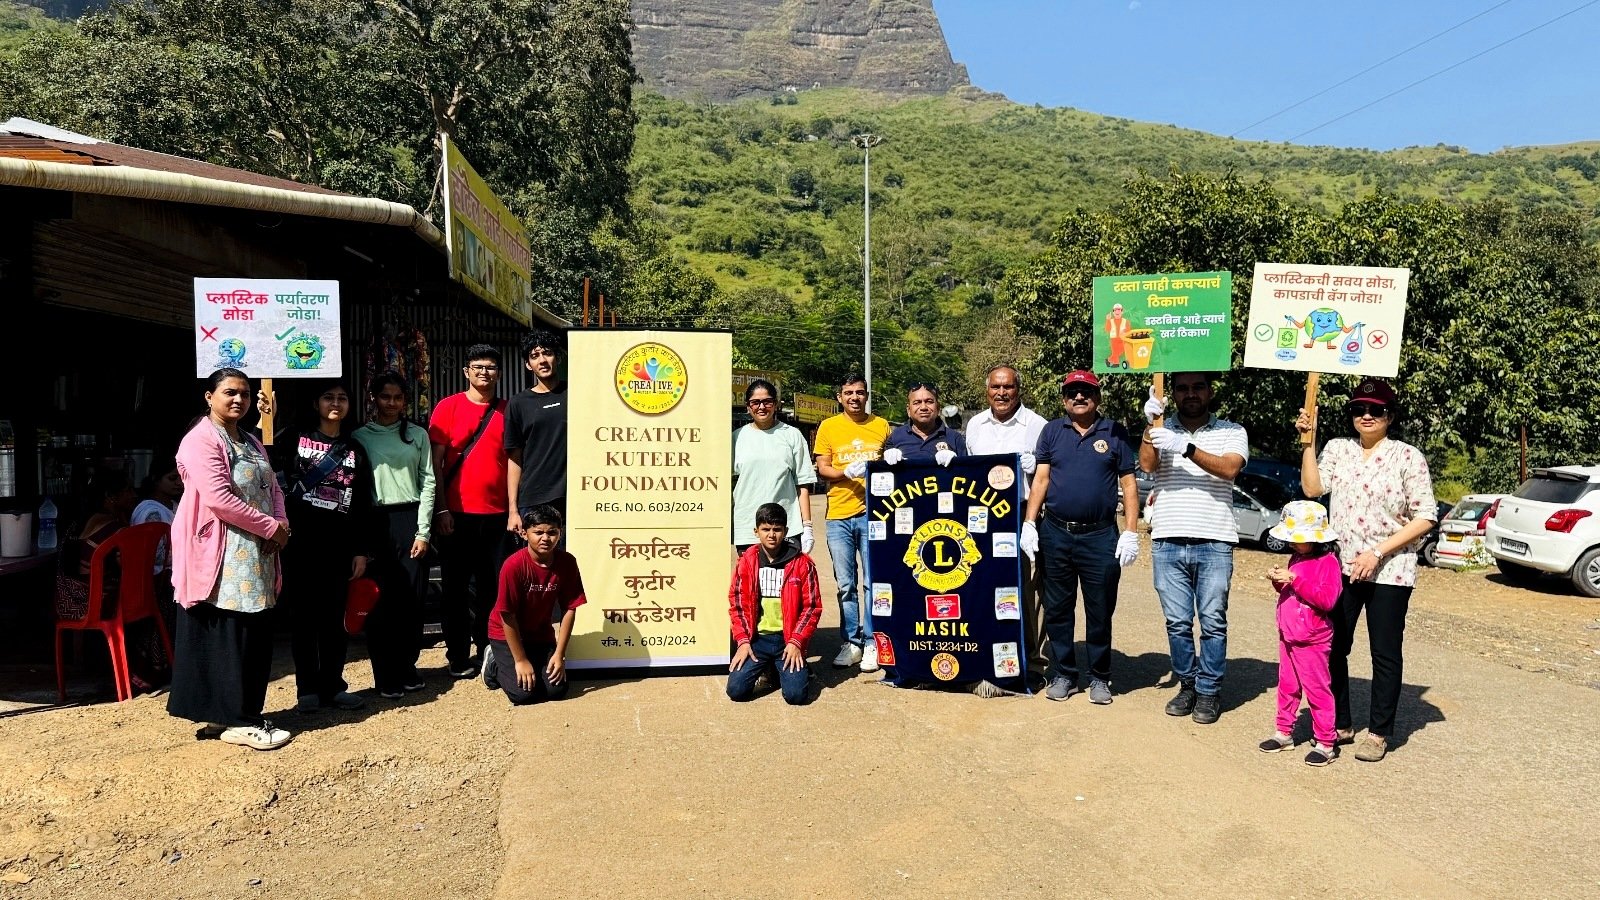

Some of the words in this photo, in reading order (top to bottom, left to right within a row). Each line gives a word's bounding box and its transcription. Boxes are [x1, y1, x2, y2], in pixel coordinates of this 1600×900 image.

[1113, 281, 1140, 292] रस्ता
[1142, 276, 1169, 292] नाही
[1264, 271, 1330, 286] प्लास्टिकची
[1333, 277, 1363, 288] सवय
[1366, 275, 1397, 290] सोडा,
[206, 289, 269, 305] प्लास्टिक
[275, 290, 330, 305] पर्यावरण
[1147, 294, 1189, 308] ठिकाण
[1274, 288, 1325, 301] कापडाची
[1327, 289, 1348, 302] बॅग
[1350, 290, 1383, 304] जोडा!
[222, 306, 254, 321] सोडा
[287, 306, 321, 320] जोडा!
[1183, 313, 1201, 325] आहे
[1202, 312, 1225, 324] त्याचं
[1160, 327, 1177, 338] खरं
[1177, 327, 1210, 338] ठिकाण
[628, 380, 673, 393] CREATIVE
[594, 427, 701, 443] CREATIVE
[606, 451, 692, 467] KUTEER
[581, 476, 719, 491] FOUNDATION
[872, 476, 938, 521] LIONS
[951, 476, 1011, 519] CLUB
[595, 502, 622, 512] REG.
[625, 502, 646, 512] NO.
[648, 502, 704, 513] 603/2024
[920, 522, 963, 538] LIONS
[609, 537, 690, 560] क्रिएटिव्ह
[933, 541, 954, 567] L
[623, 569, 677, 598] कुटीर
[602, 601, 697, 623] फाऊंडेशन
[915, 621, 970, 636] NASIK
[601, 636, 621, 647] रजि.
[624, 635, 635, 647] नं.
[641, 635, 697, 647] 603/2024
